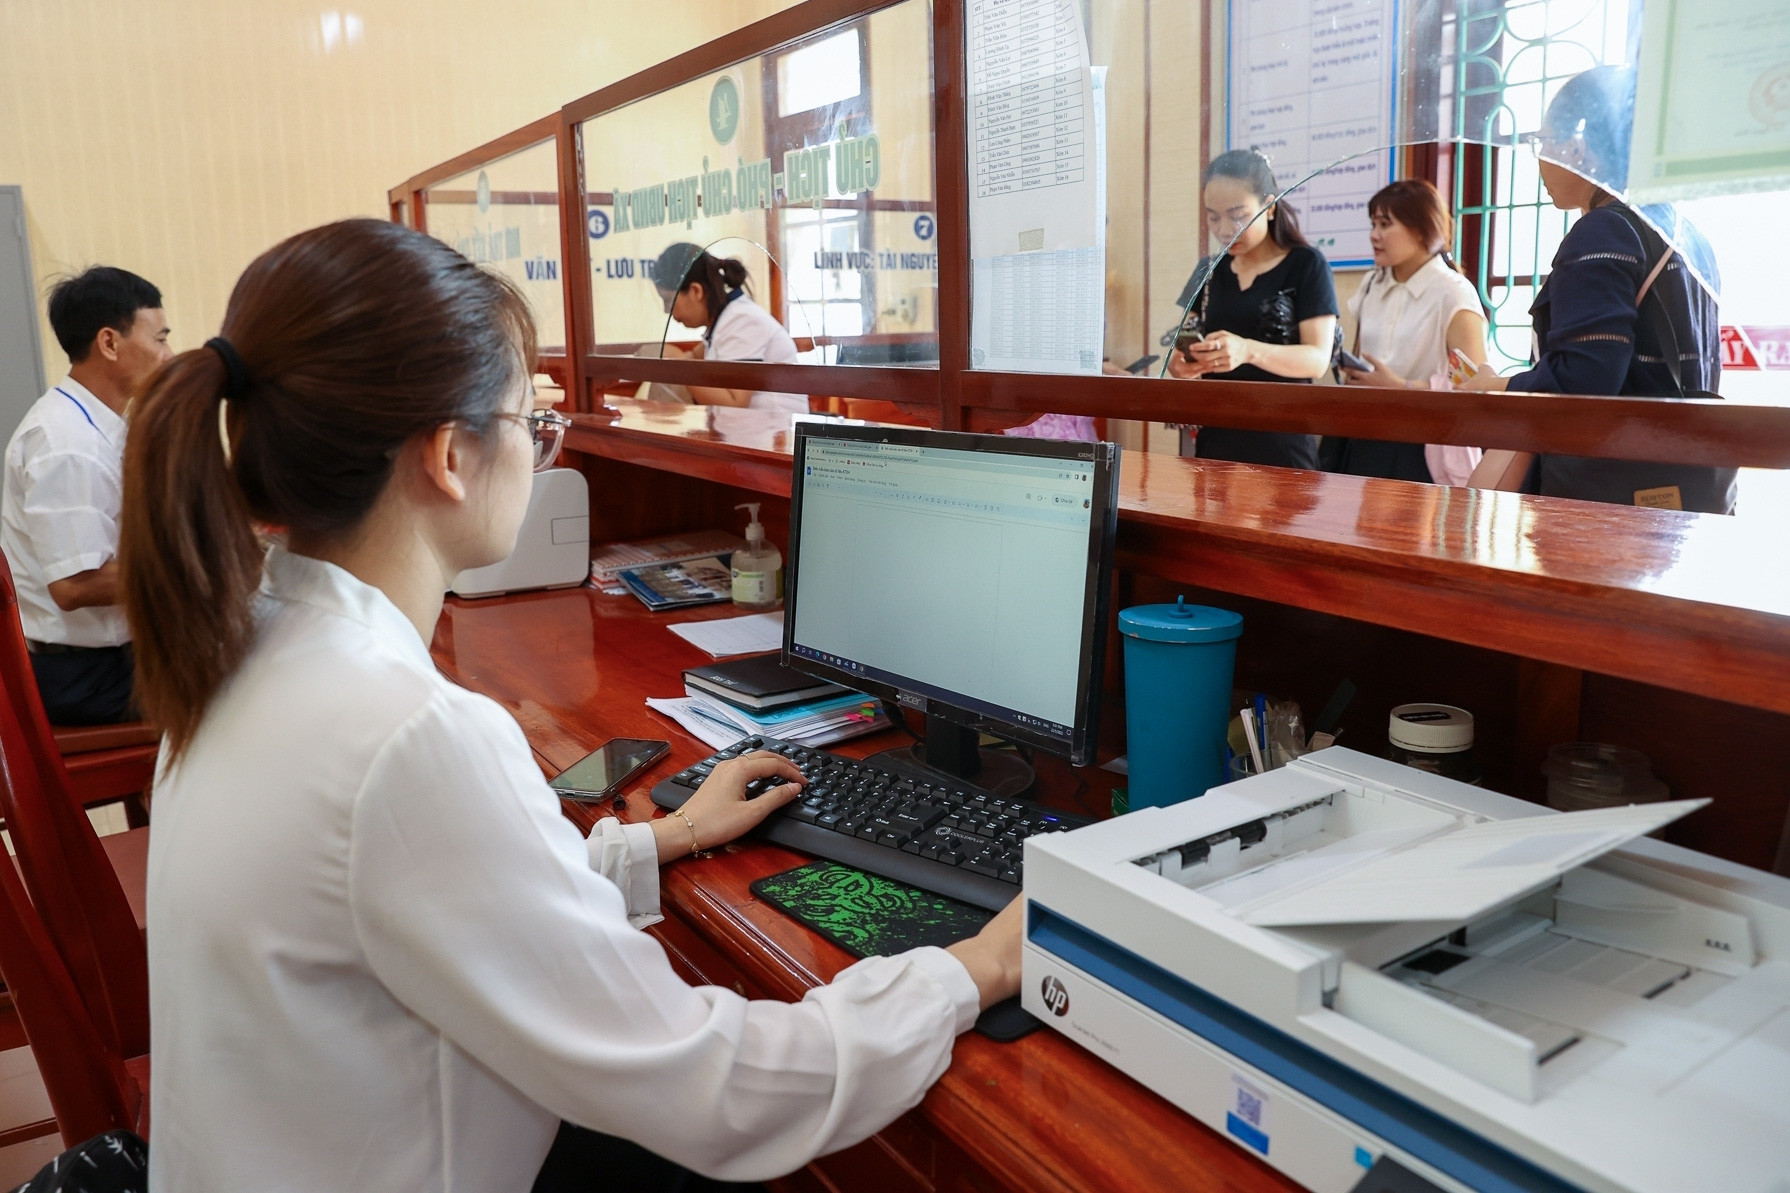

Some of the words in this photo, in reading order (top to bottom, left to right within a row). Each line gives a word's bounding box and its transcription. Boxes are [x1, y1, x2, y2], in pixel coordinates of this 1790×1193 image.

[640, 259, 656, 279] TR
[902, 694, 922, 705] acer
[1043, 975, 1068, 1016] hp
